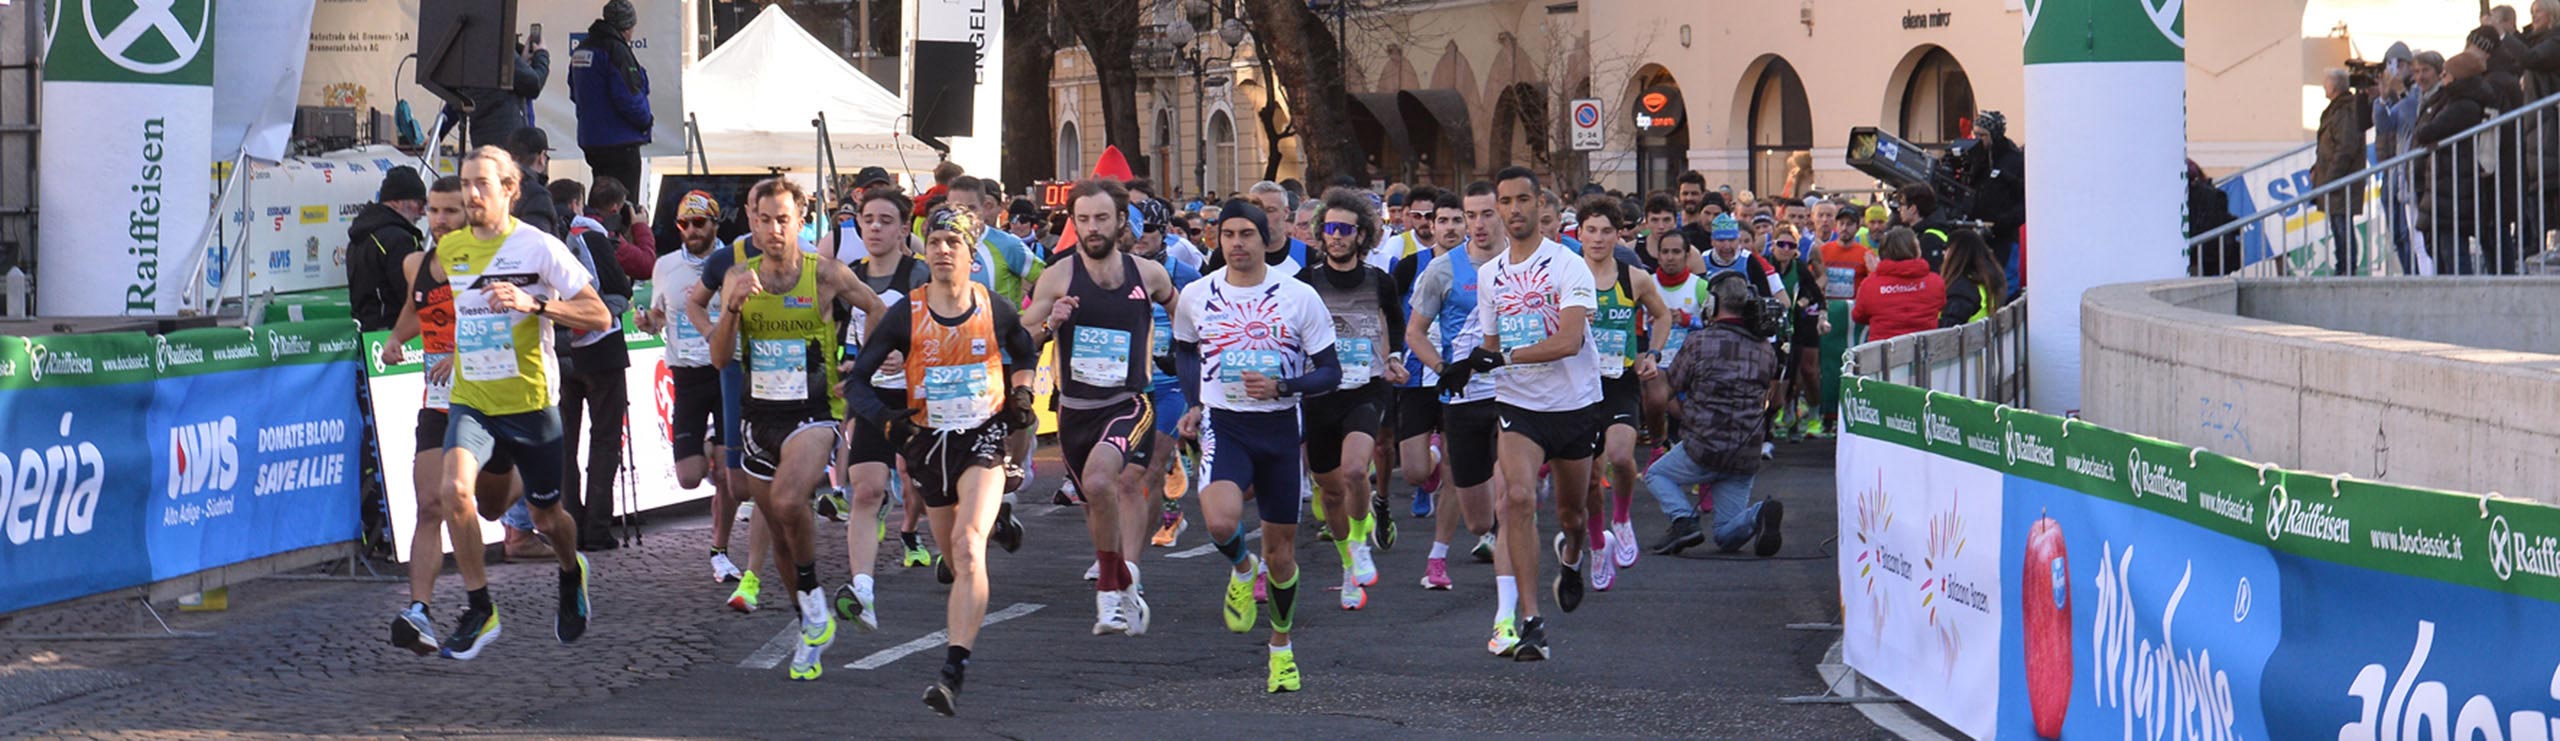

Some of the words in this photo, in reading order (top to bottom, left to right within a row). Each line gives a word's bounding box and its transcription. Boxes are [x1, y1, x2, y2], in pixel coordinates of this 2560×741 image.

[1902, 9, 1927, 30] elena
[125, 116, 165, 316] Raiffeisen
[268, 249, 291, 269] AVIS
[460, 320, 488, 337] 505
[1501, 318, 1526, 332] 501
[1079, 328, 1109, 345] 523
[754, 341, 783, 358] 506
[1225, 351, 1258, 367] 924
[931, 367, 965, 384] 522
[257, 422, 305, 454] DONATE
[305, 418, 345, 447] BLOOD
[167, 415, 239, 499] AVIS
[253, 458, 299, 497] SAVE
[296, 457, 311, 489] A
[309, 453, 345, 487] LIFE
[2014, 430, 2056, 468] Raiffeisen
[2141, 460, 2188, 504] Raiffeisen
[2199, 490, 2254, 525] www.boclassic.it
[2284, 499, 2351, 544] Raiffeisen
[2370, 526, 2464, 561] www.boclassic.it
[162, 505, 179, 527] Alto
